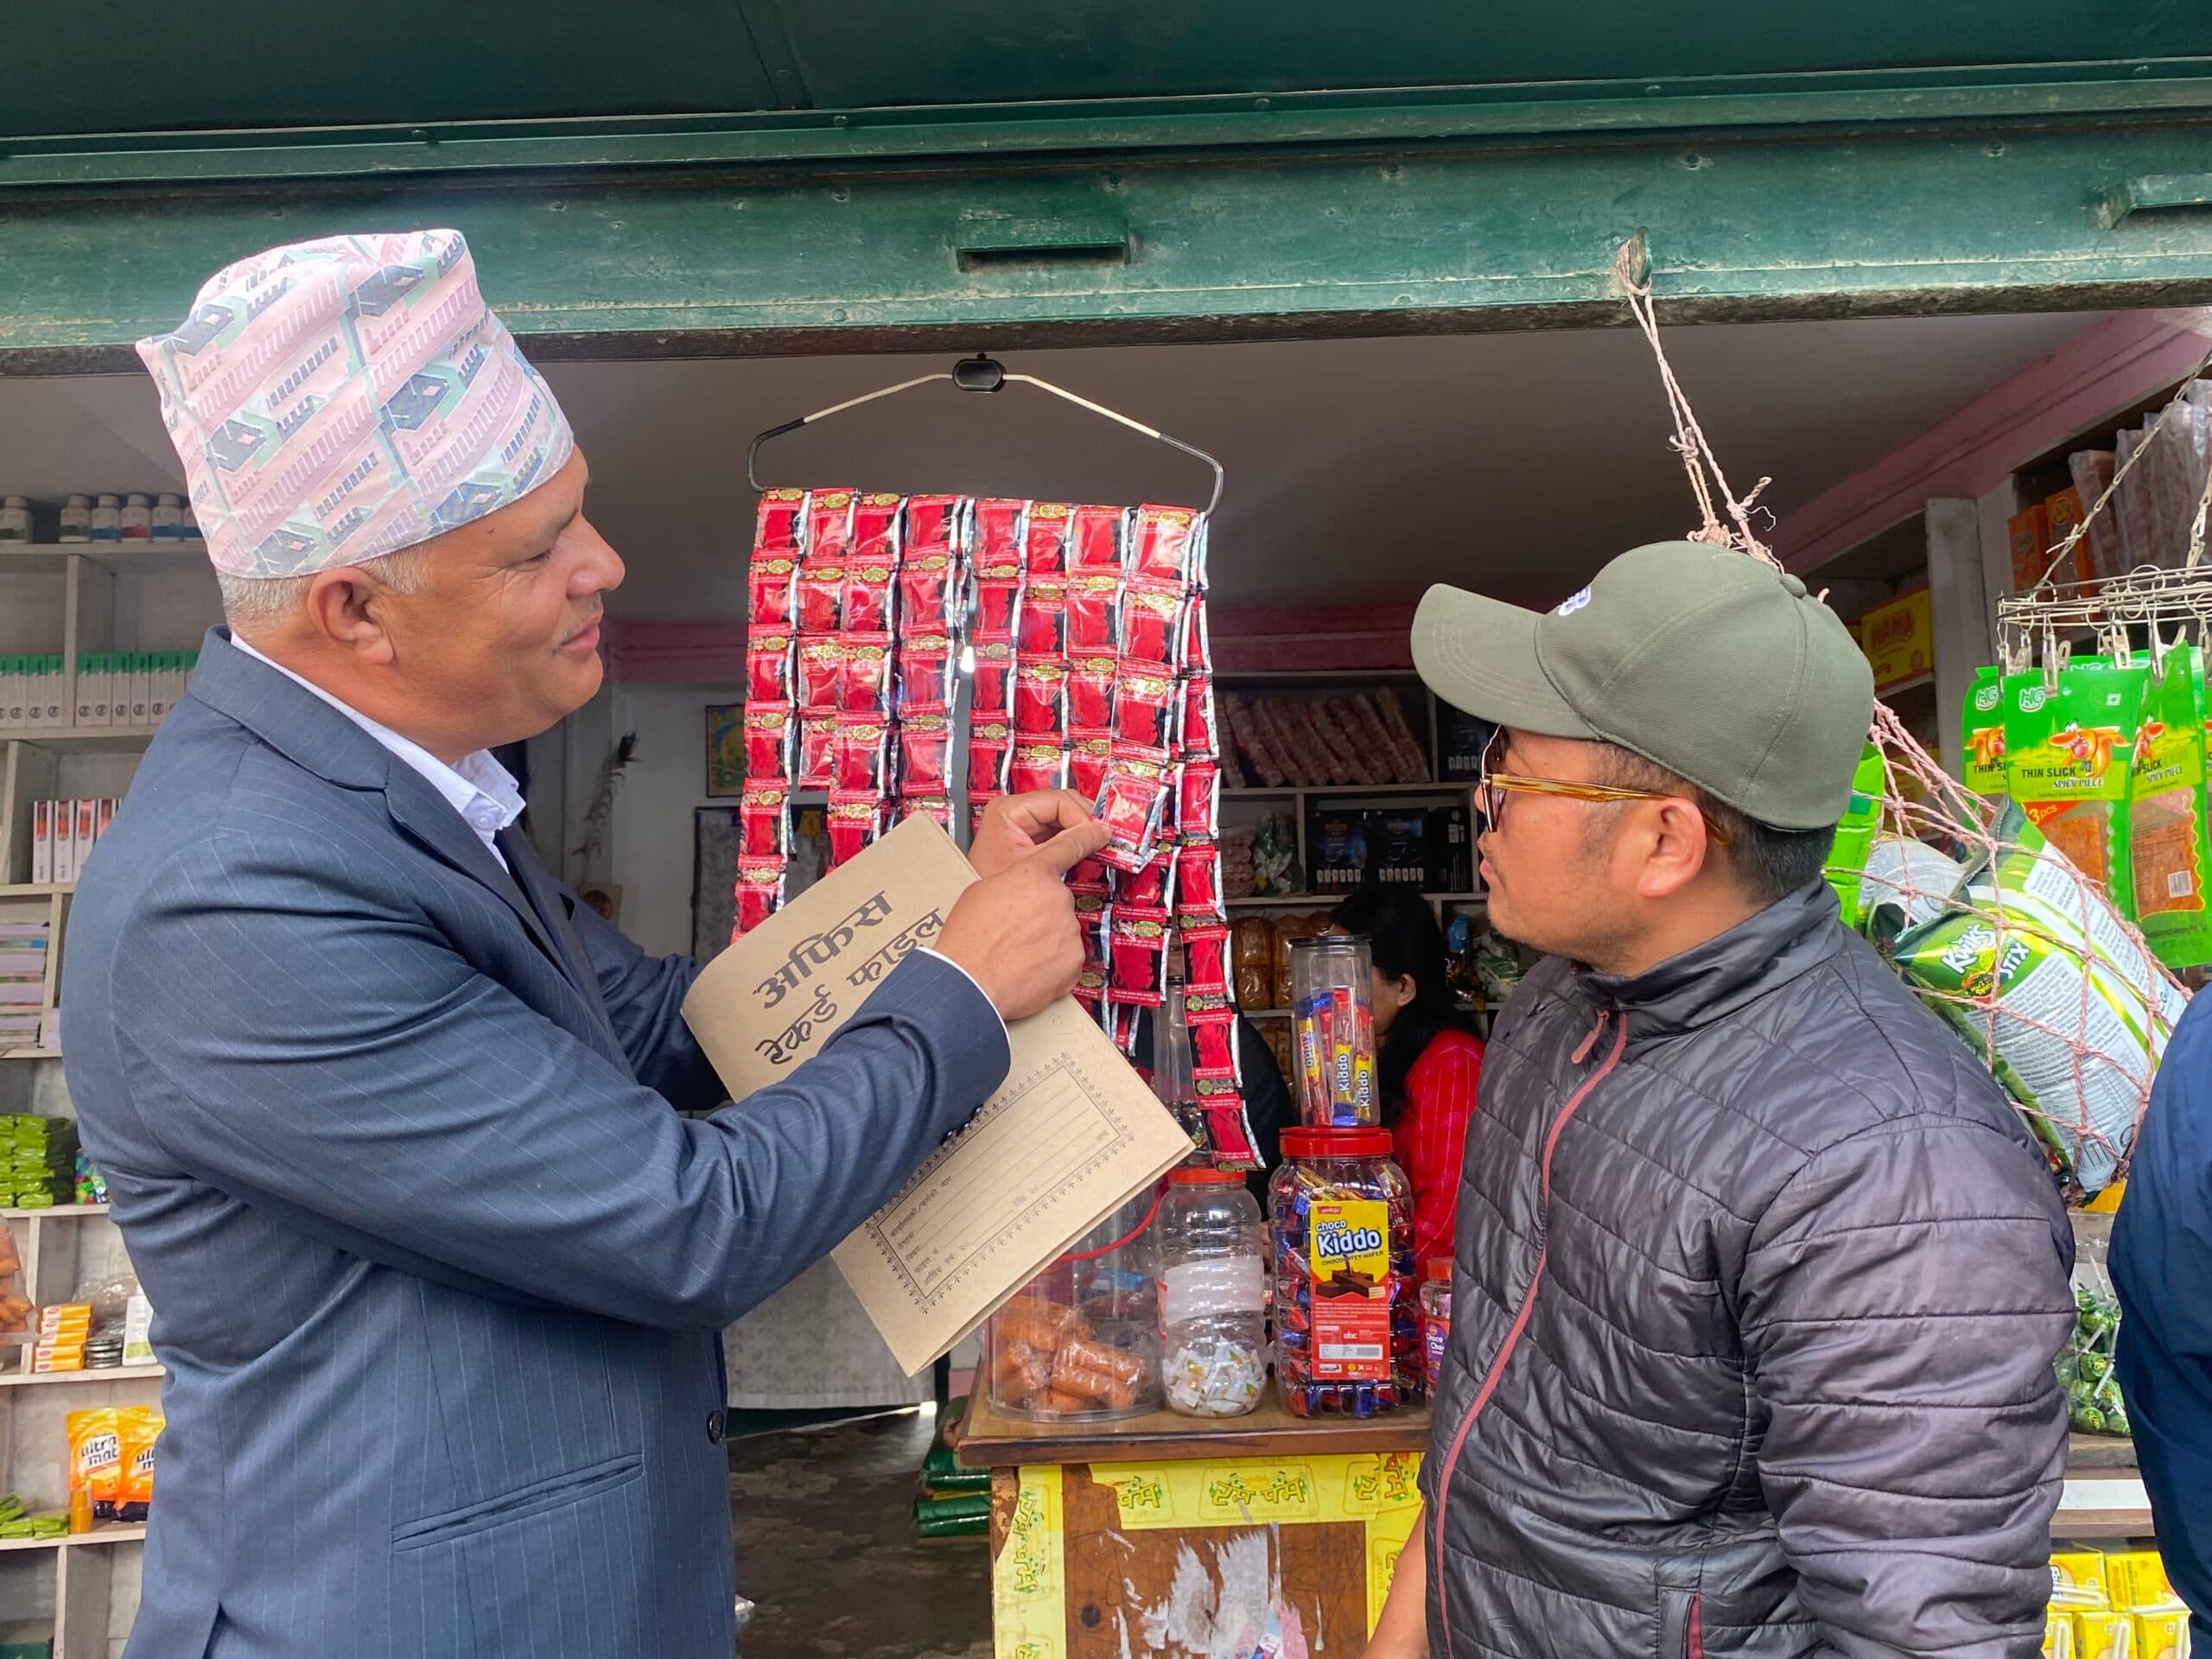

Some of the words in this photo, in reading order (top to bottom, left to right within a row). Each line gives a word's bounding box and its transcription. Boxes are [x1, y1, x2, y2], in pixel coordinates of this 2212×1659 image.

[2019, 685, 2045, 712] HG
[2022, 768, 2044, 779] THIN
[2047, 766, 2075, 778] SLICK
[2054, 779, 2076, 789] SPICY
[2079, 778, 2103, 788] PIECE
[753, 889, 894, 1009] अफिस
[754, 982, 838, 1065] रेकर्ड
[845, 907, 946, 988] फाइल
[1337, 1053, 1350, 1091] Kiddo
[1358, 1070, 1370, 1107] Kiddo
[1316, 1220, 1346, 1232] choco
[1317, 1228, 1382, 1257] Kiddo
[81, 1436, 117, 1457] ultra
[89, 1447, 118, 1465] mat
